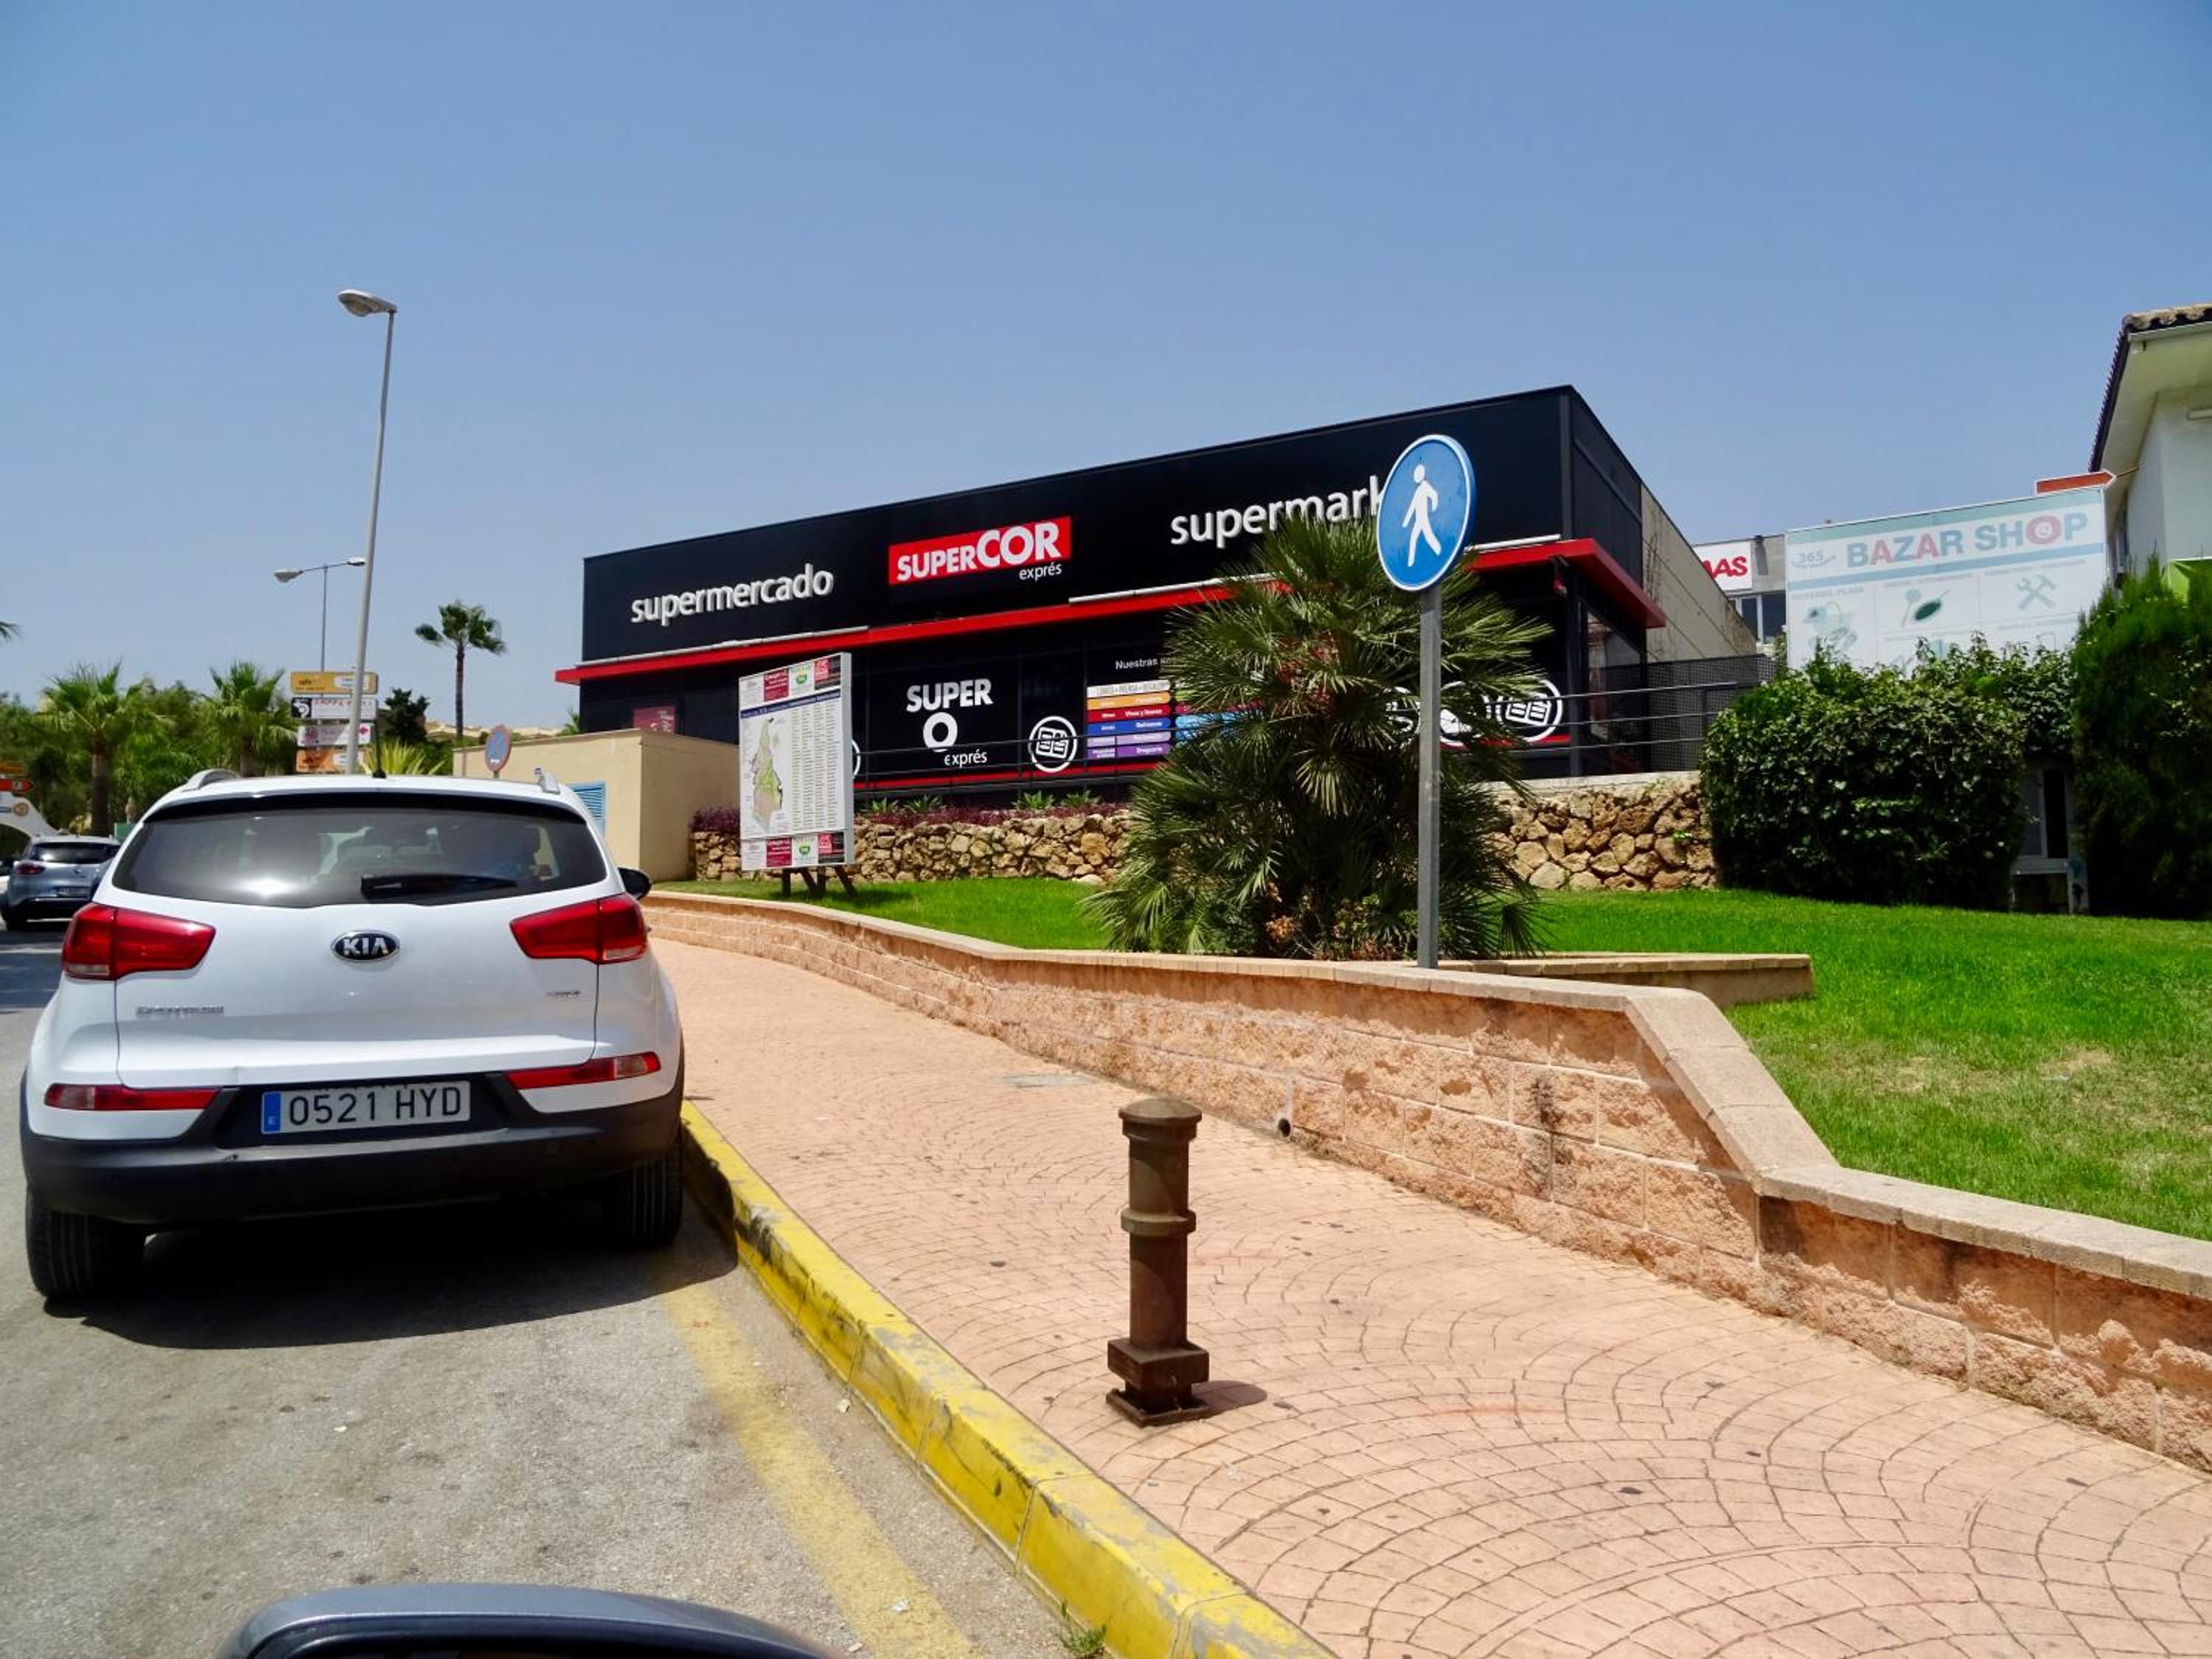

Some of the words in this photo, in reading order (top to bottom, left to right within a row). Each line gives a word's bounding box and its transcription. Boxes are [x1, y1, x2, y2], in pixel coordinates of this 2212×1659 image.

[897, 522, 1062, 582] SUPERCOR
[1846, 529, 1964, 568] BAZAR
[1975, 512, 2088, 551] SHOP
[1019, 562, 1062, 582] exprés
[631, 563, 834, 626] supermercado
[1116, 658, 1158, 669] Nuestras
[906, 678, 994, 712] SUPER
[944, 748, 987, 768] exprés
[343, 937, 389, 956] KIA
[289, 1091, 375, 1126] 0521
[395, 1087, 462, 1119] HYD
